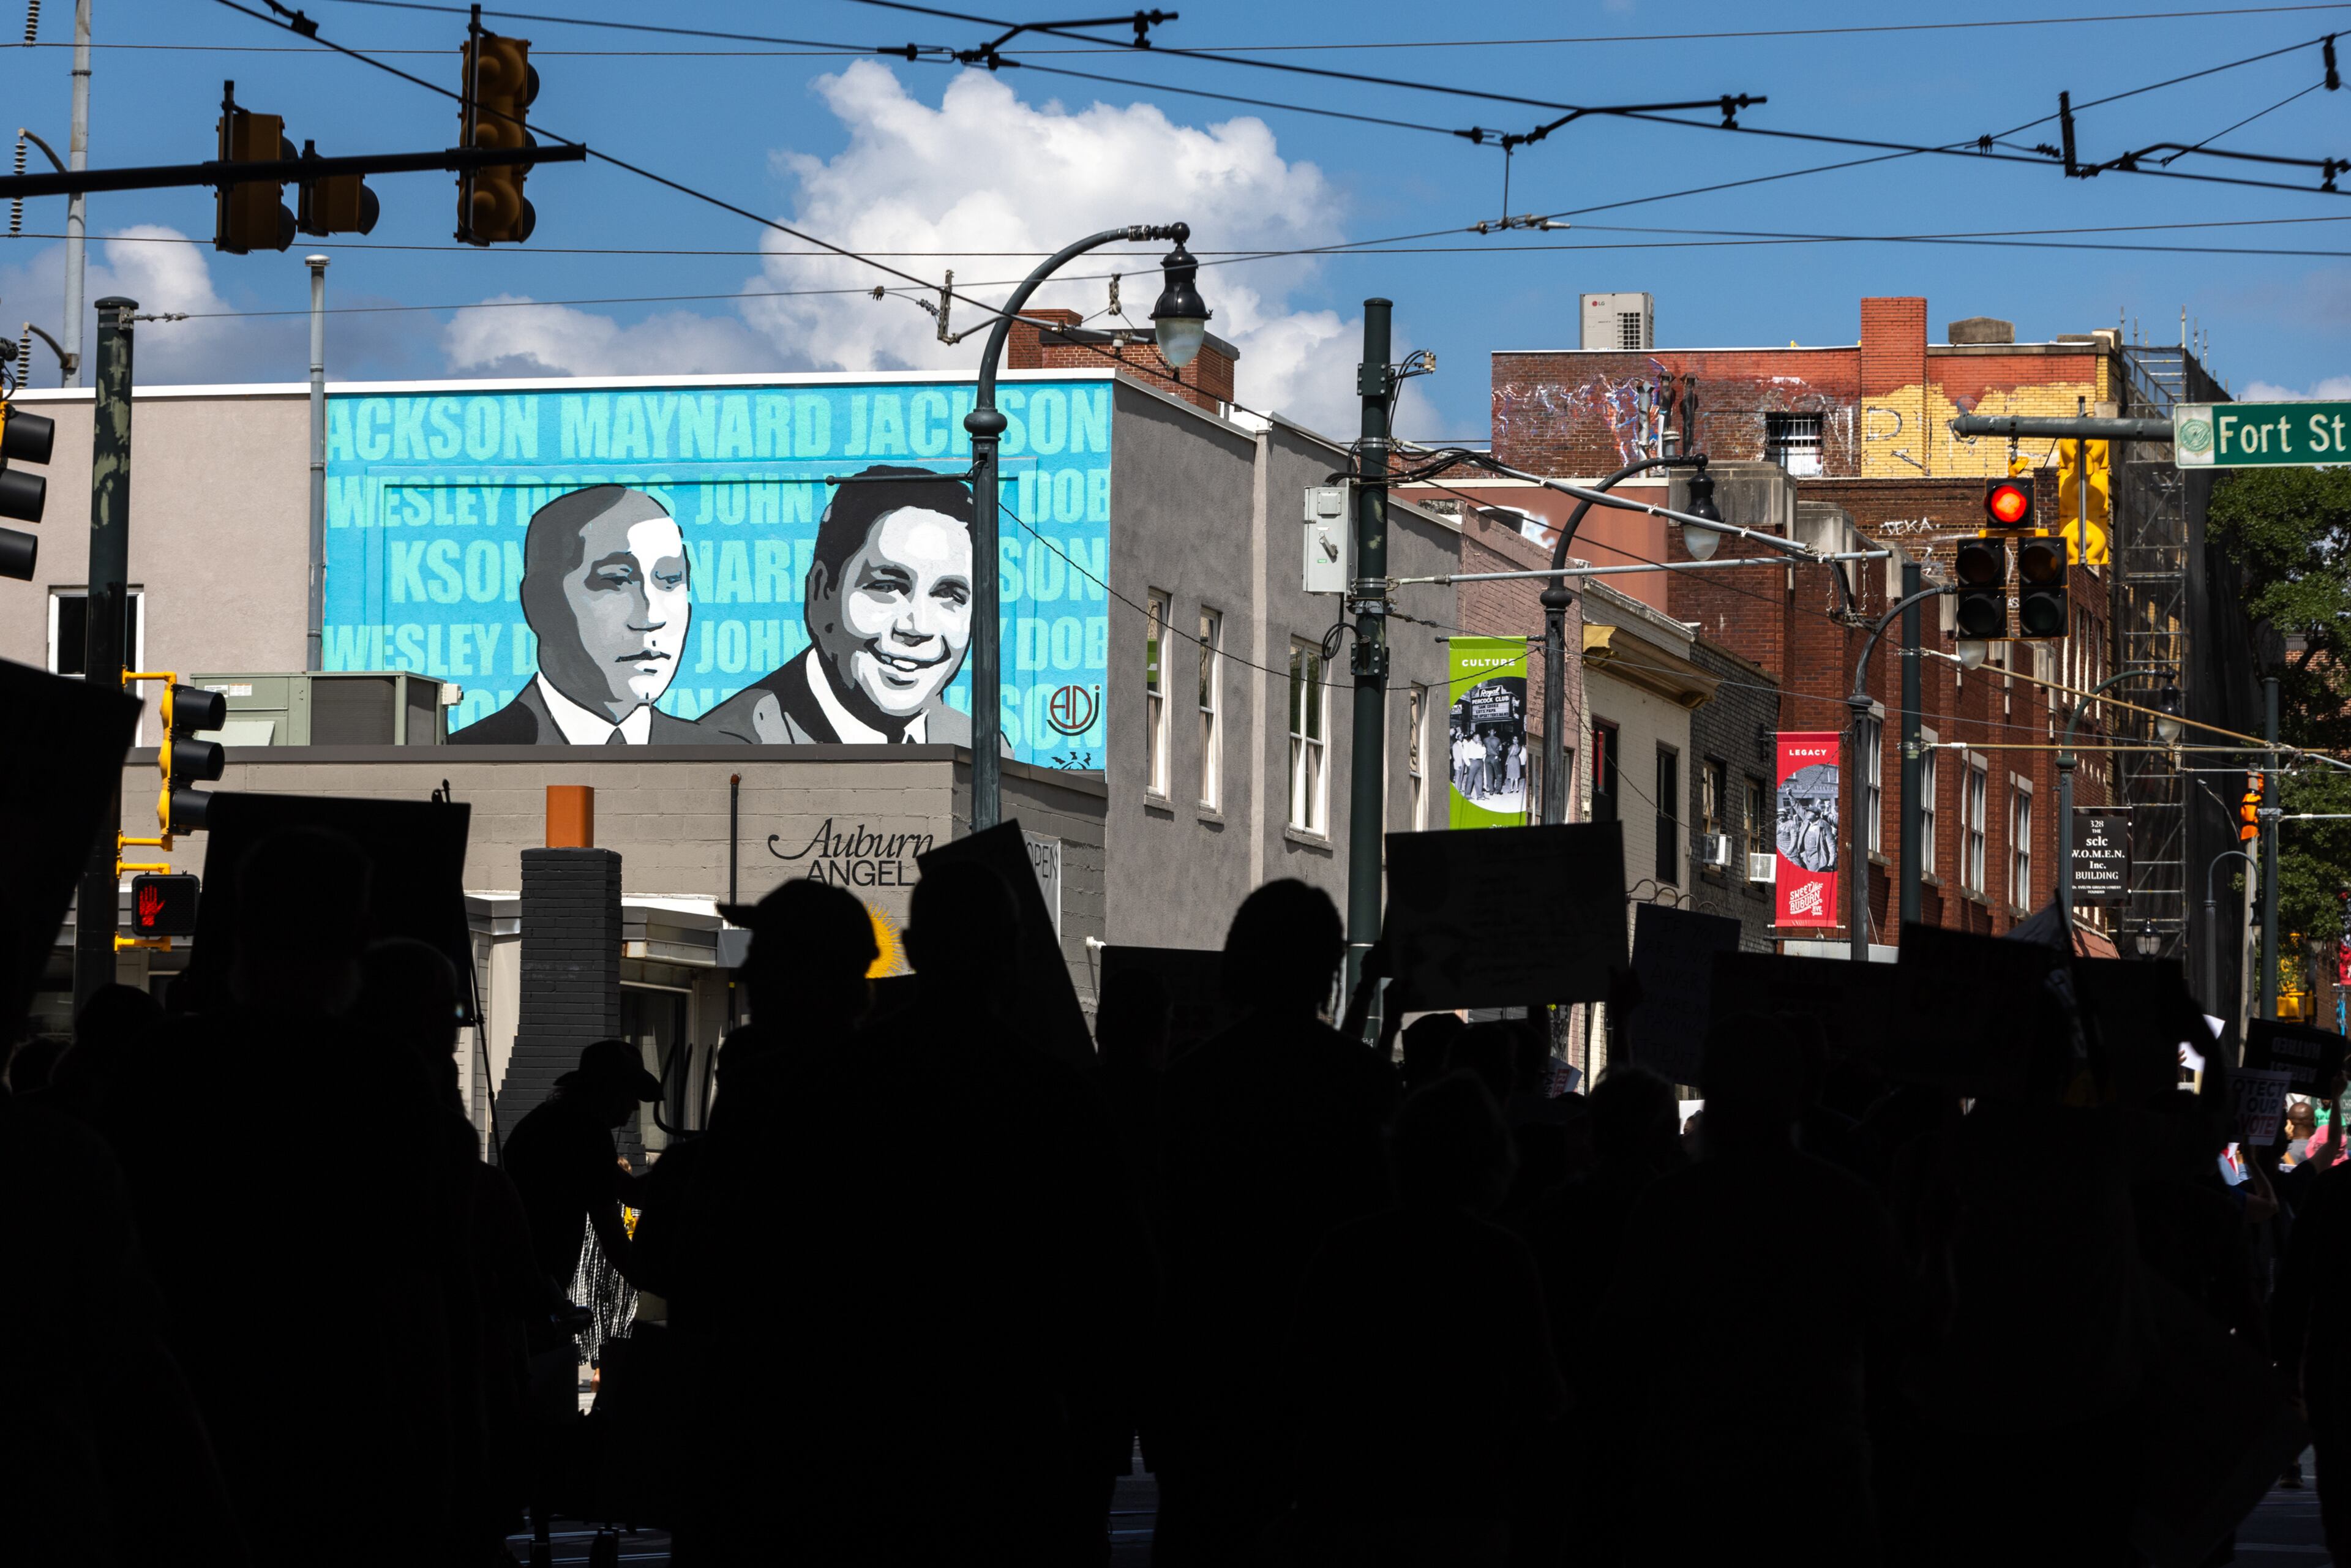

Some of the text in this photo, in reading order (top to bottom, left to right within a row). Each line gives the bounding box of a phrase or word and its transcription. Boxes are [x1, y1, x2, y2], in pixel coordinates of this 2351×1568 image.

[560, 392, 831, 459] MAYNARD
[2219, 413, 2347, 454] Fort St
[327, 473, 508, 528] WESLEY
[695, 472, 812, 525] JOHN
[323, 623, 502, 676] WESLEY
[695, 618, 812, 674] JOHN
[1461, 658, 1516, 667] CULTURE
[767, 817, 934, 861] Auburn
[2085, 836, 2109, 847] sclc
[2071, 849, 2125, 858] W.O.M.E.N.
[2089, 860, 2107, 869] Inc.
[805, 860, 916, 887] ANGEL
[2075, 871, 2119, 880] BUILDING
[1790, 883, 1812, 901] SWEET
[1790, 890, 1820, 911] AUBURN
